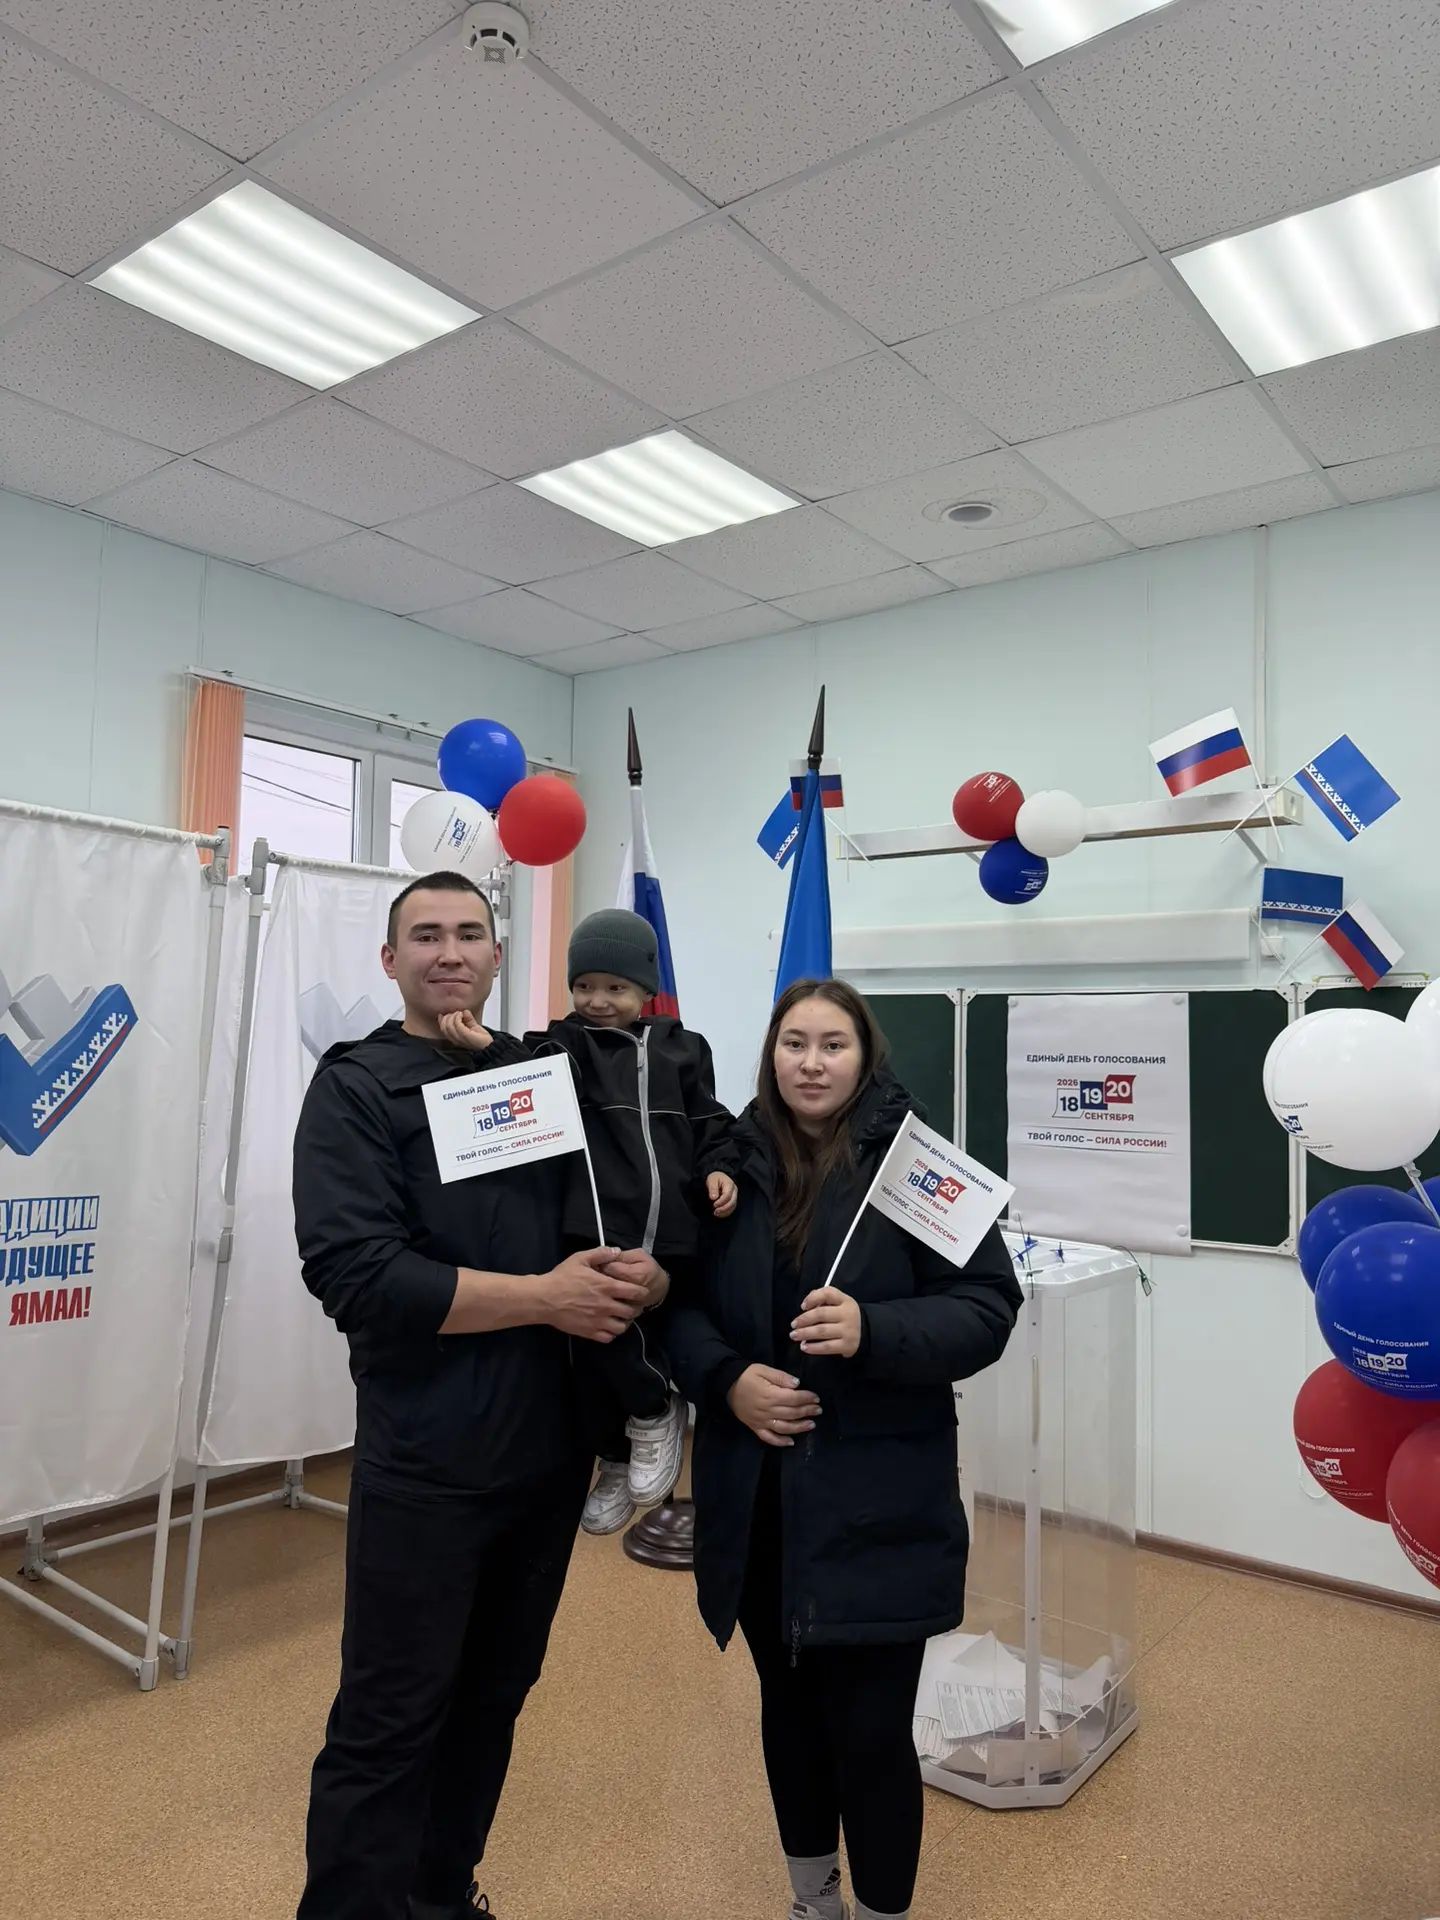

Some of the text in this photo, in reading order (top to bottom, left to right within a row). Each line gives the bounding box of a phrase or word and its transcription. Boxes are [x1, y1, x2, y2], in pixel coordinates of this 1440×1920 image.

[1026, 1053, 1166, 1064] ЕДИНЫЙ ДЕНЬ ГОЛОСОВАНИЯ
[442, 1070, 553, 1101] ЕДИНЫЙ ДЕНЬ ГОЛОСОВАНИЯ
[1056, 1078, 1078, 1086] 2026
[1059, 1080, 1130, 1112] 18 19 20
[471, 1103, 490, 1113] 2026
[477, 1095, 531, 1132] 18 19 20
[1084, 1112, 1134, 1121] СЕНТЯБРЯ
[499, 1118, 538, 1133] СЕНТЯБРЯ
[456, 1151, 477, 1162] ТВОЙ
[478, 1145, 504, 1157] ГОЛОС
[511, 1138, 532, 1149] СИЛА
[532, 1130, 565, 1144] РОССИИ!
[1027, 1131, 1052, 1141] ТВОЙ
[1053, 1134, 1085, 1143] ГОЛОС
[1095, 1136, 1121, 1145] СИЛА
[1123, 1138, 1167, 1148] РОССИИ!
[909, 1130, 993, 1194] ЕДИНЫЙ ДЕНЬ ГОЛОСОВАНИЯ
[907, 1171, 959, 1197] 18 19 20
[891, 1193, 910, 1210] ГОЛОС
[913, 1210, 930, 1224] СИЛА
[916, 1191, 949, 1216] СЕНТЯБРЯ
[9, 1286, 92, 1326] ЯМАЛ!
[1375, 1339, 1429, 1348] ГОЛОСОВАНИЯ
[1355, 1356, 1404, 1368] 18 19 20
[1325, 1462, 1339, 1472] 20
